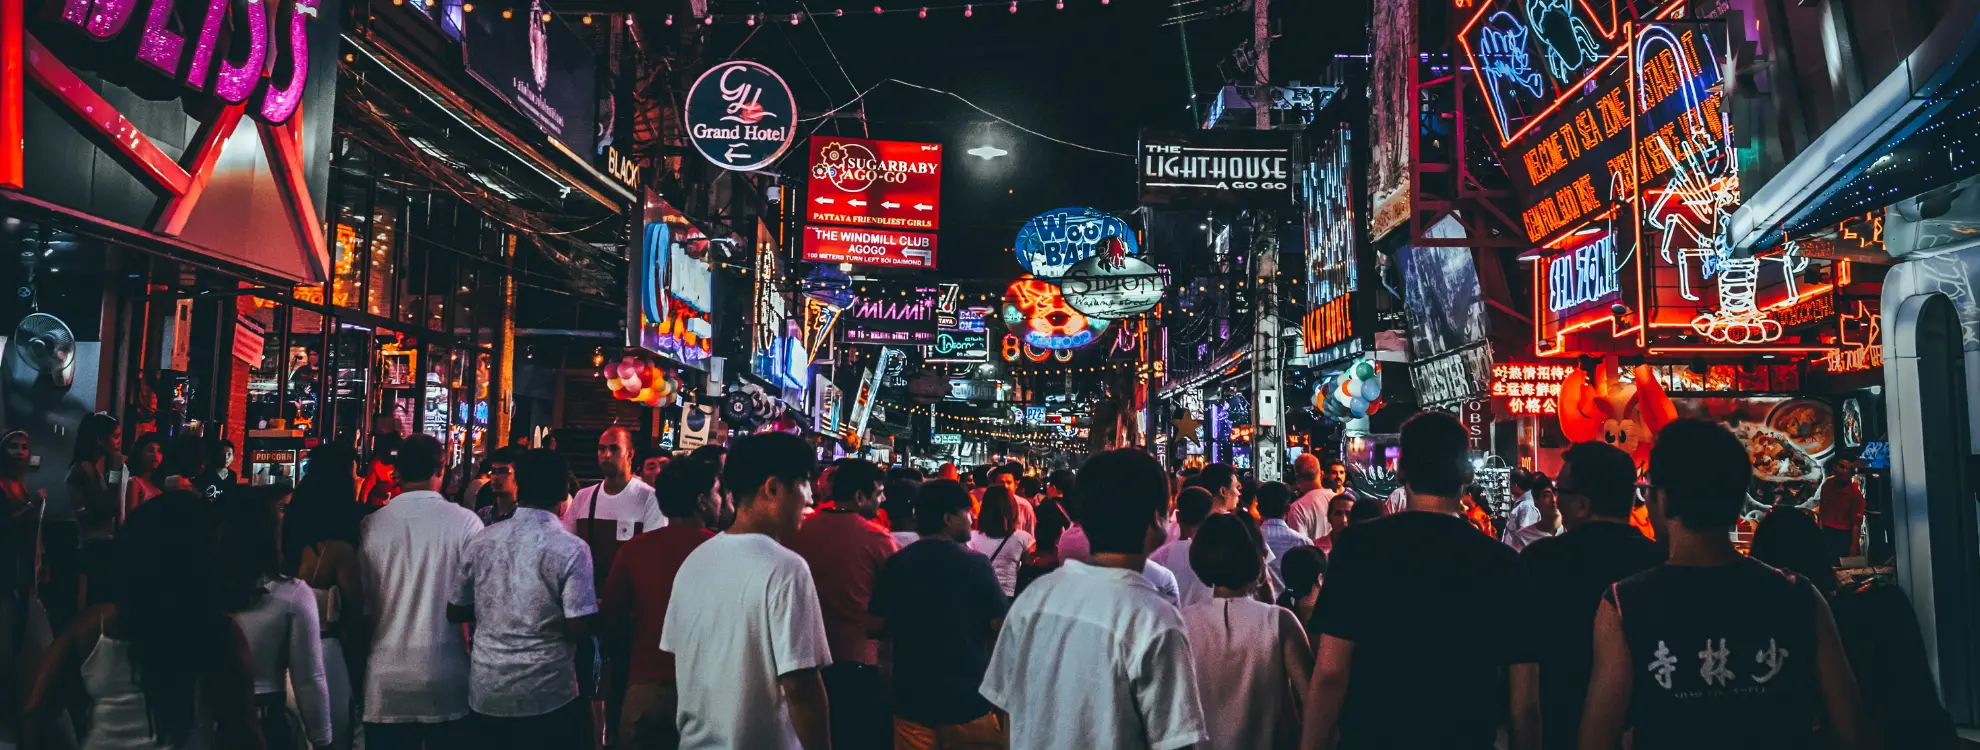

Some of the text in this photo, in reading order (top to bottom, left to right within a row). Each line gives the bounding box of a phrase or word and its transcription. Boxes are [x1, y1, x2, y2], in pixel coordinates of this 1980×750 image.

[693, 123, 786, 142] Grand Hotel
[1522, 131, 1568, 186] WELCOME
[1560, 123, 1581, 160] TO
[1575, 108, 1604, 151] SEA
[1596, 87, 1632, 139] ZONE
[1145, 145, 1181, 154] THE
[847, 158, 938, 174] SUGARBABY
[1145, 155, 1287, 180] LIGHTHOUSE
[843, 168, 907, 184] AGO-GO
[1216, 181, 1287, 190] A GO GO
[813, 212, 932, 228] PATTAYA FRIENDLIEST GIRLS
[816, 229, 930, 248] THE WINDMILL CLUB
[819, 253, 844, 261] METERS
[848, 243, 886, 256] AGOGO
[1072, 270, 1157, 295] SIMON
[1550, 255, 1577, 312] SEA
[1509, 397, 1556, 413] 价格公
[256, 453, 292, 461] POPCORN
